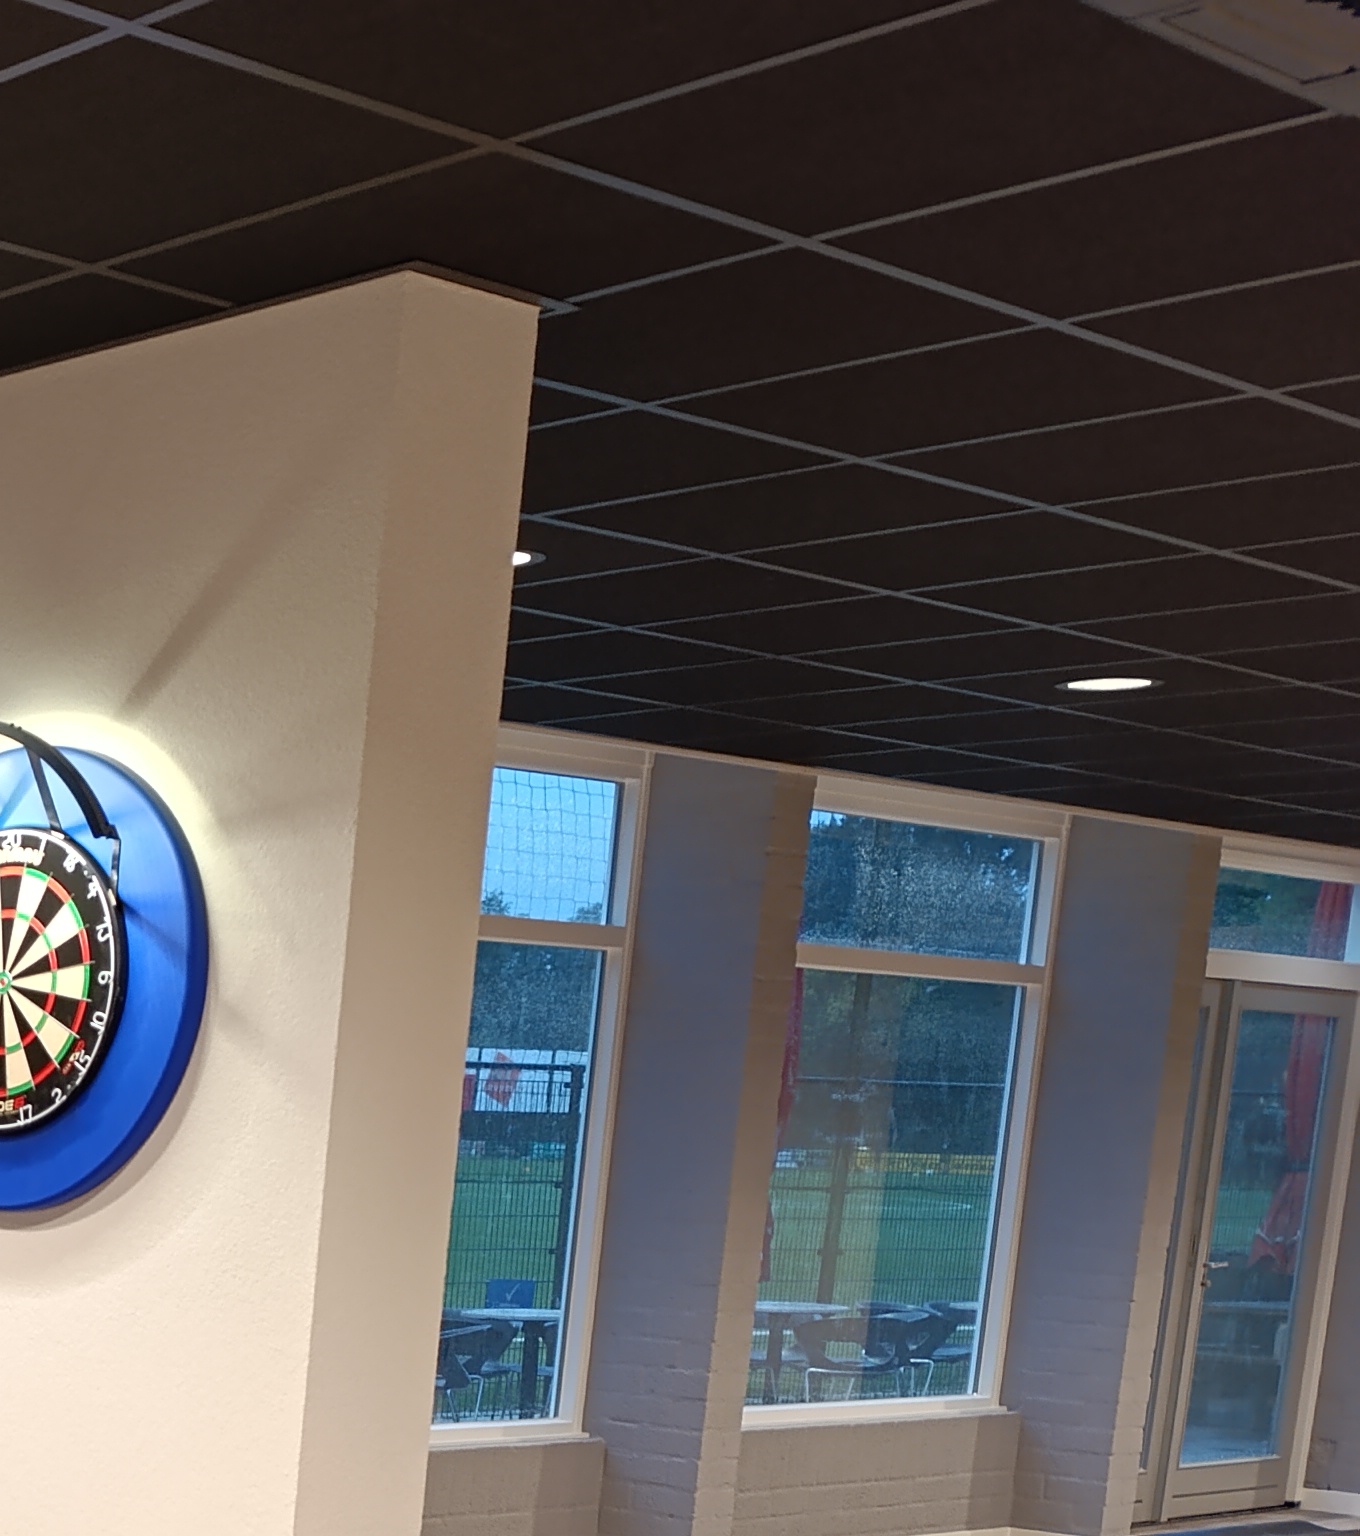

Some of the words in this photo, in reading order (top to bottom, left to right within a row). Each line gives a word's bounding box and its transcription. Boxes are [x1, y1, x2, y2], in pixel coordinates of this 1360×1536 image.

[1, 832, 22, 850] 20
[98, 970, 113, 985] 6
[90, 1011, 107, 1035] 10
[74, 1049, 91, 1075] 15
[51, 1087, 67, 1104] 2
[17, 1104, 33, 1125] 17
